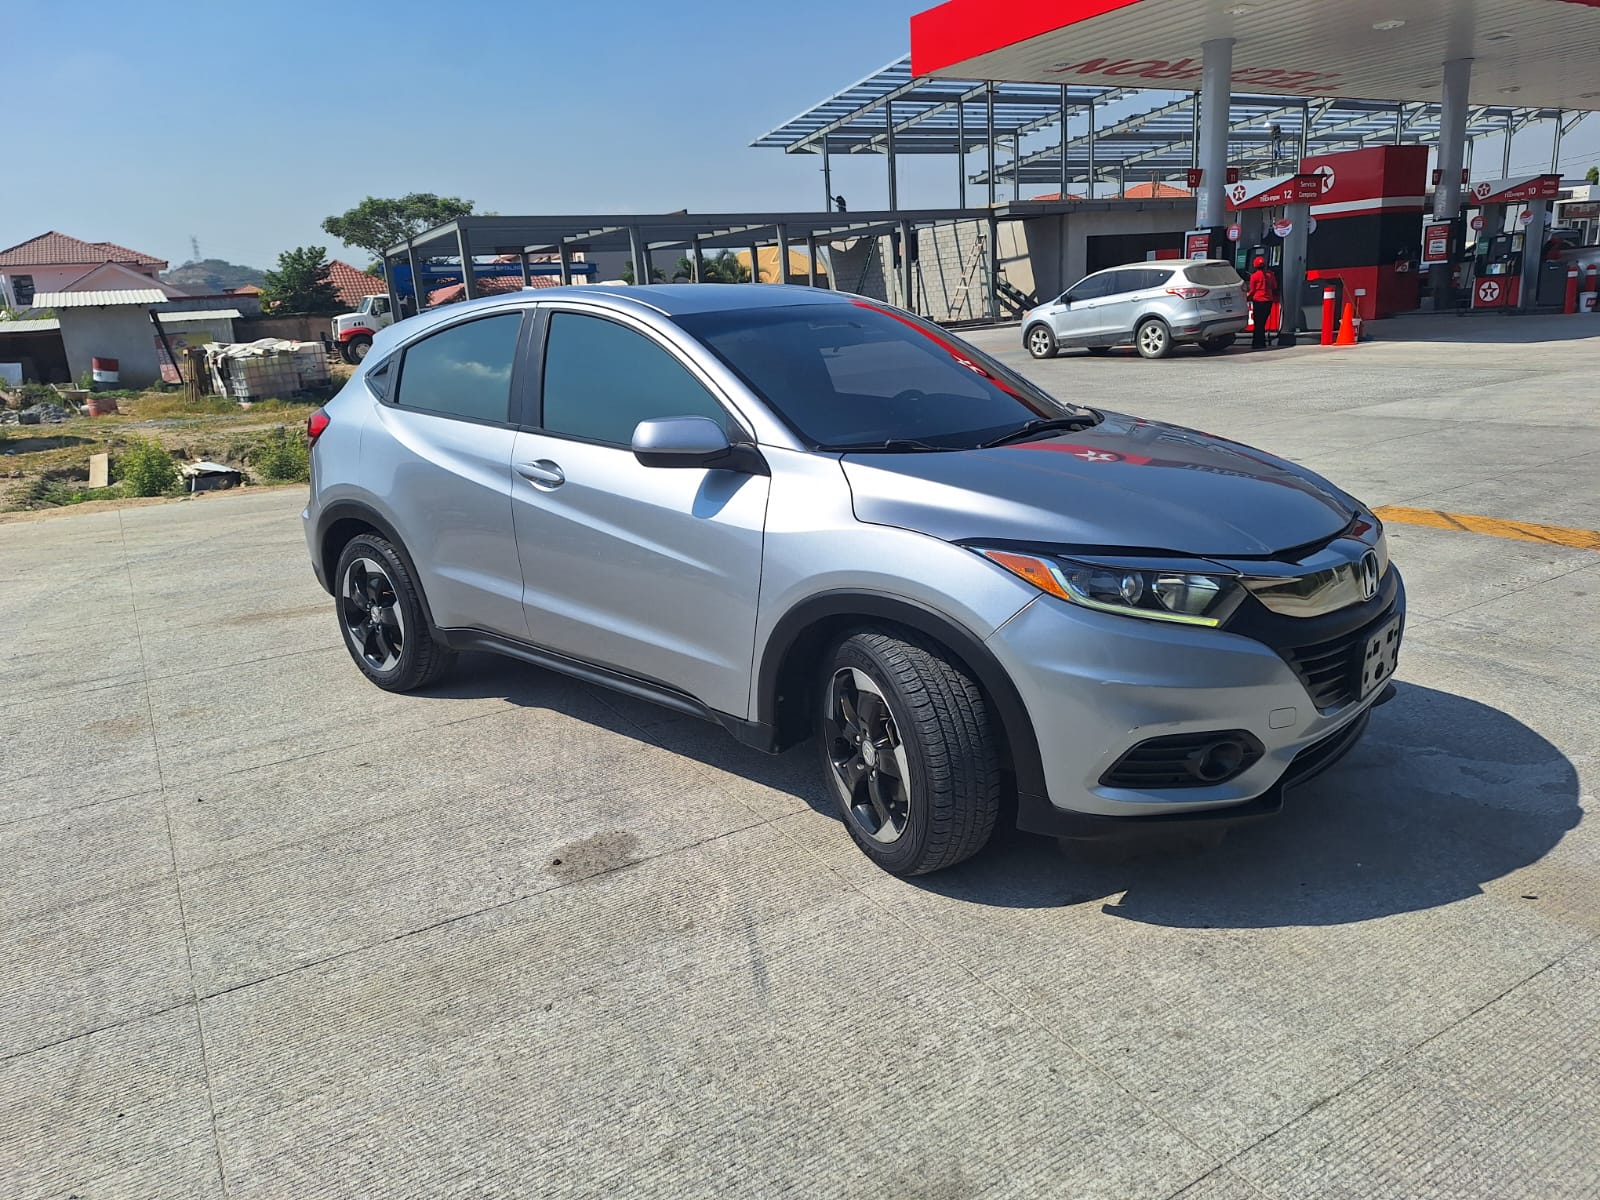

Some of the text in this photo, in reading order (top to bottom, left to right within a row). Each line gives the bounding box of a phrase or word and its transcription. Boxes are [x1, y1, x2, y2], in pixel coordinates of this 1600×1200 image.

[1189, 174, 1196, 183] 12
[1284, 190, 1292, 199] 12
[1528, 187, 1537, 195] 10
